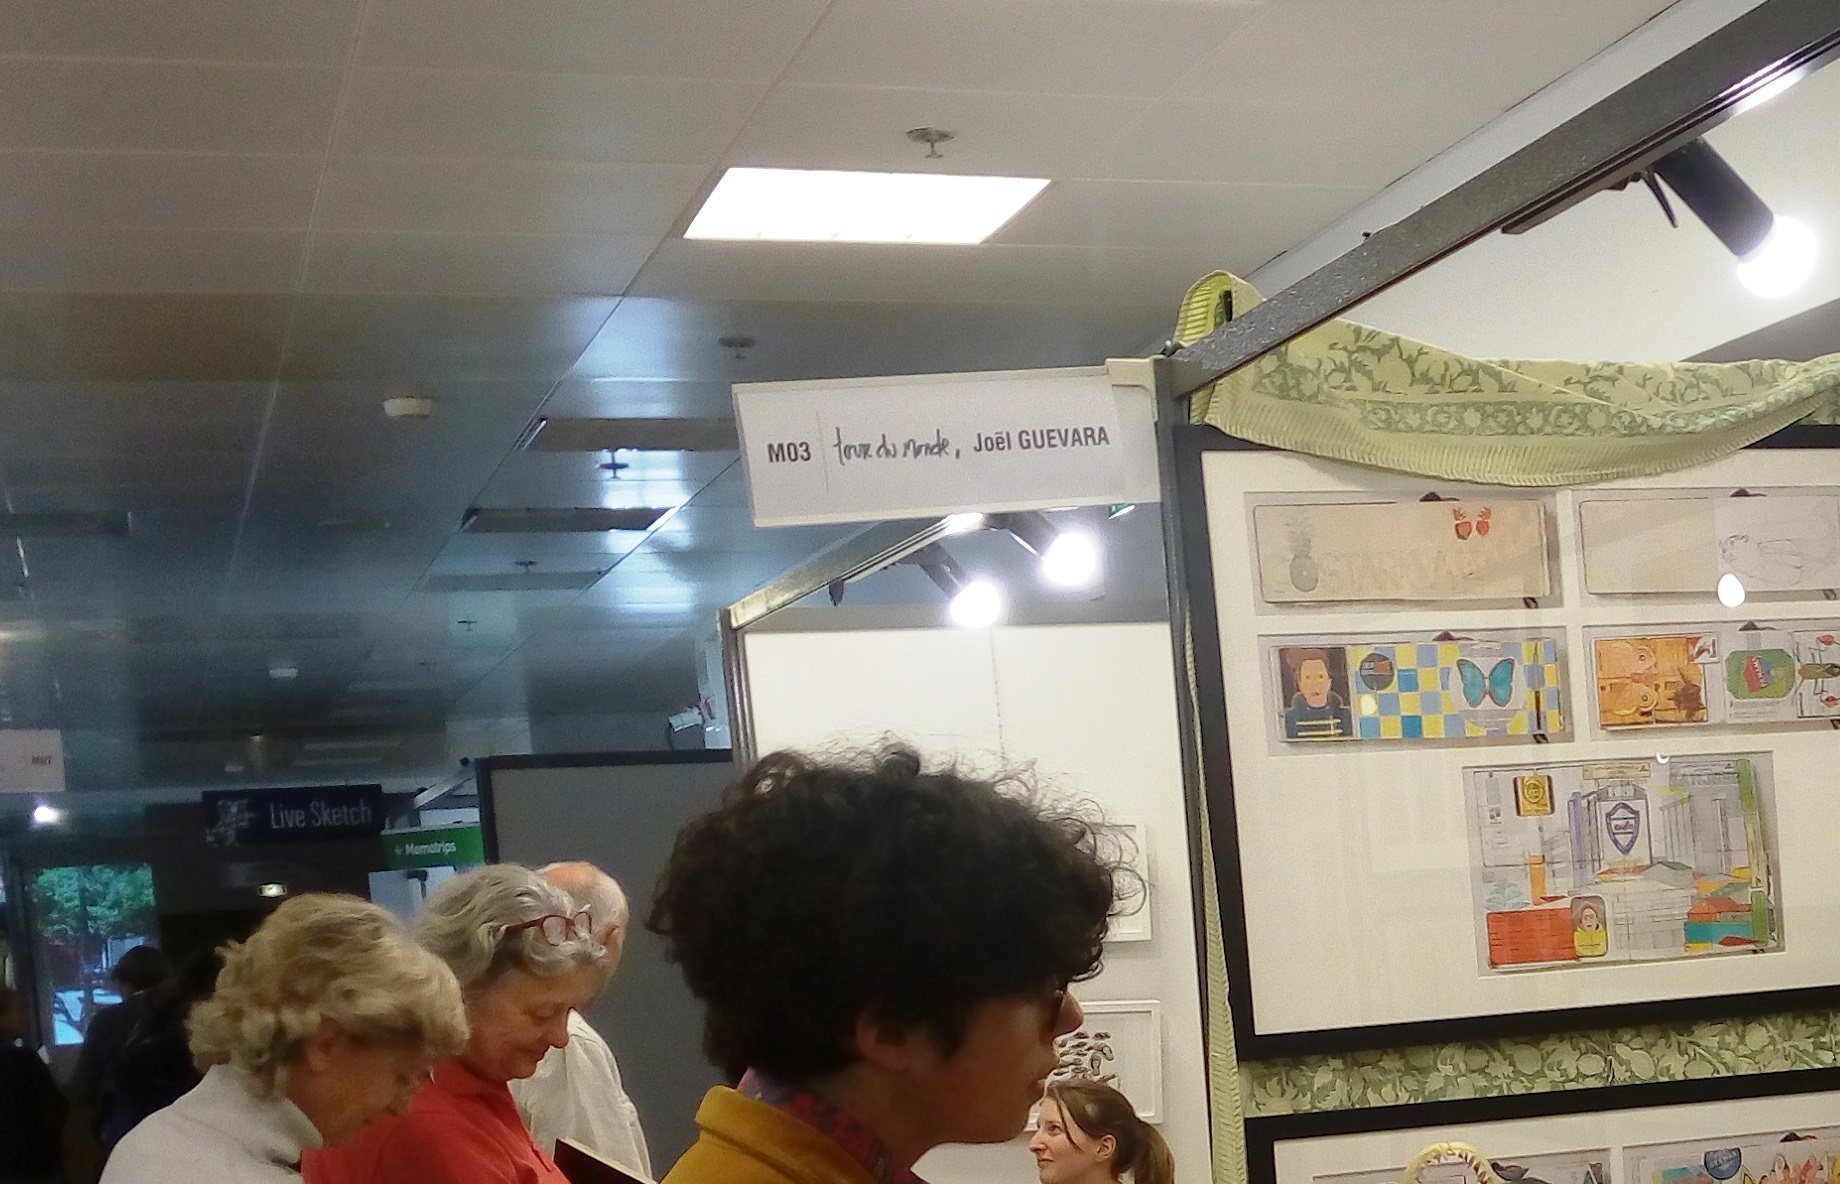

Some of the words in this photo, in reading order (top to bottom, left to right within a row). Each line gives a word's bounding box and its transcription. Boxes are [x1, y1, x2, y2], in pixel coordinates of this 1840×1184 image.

[767, 441, 811, 463] M03
[973, 430, 1012, 453] Joël
[1018, 426, 1111, 450] GUEVARA
[269, 800, 305, 830] Live
[309, 799, 373, 828] Sketch
